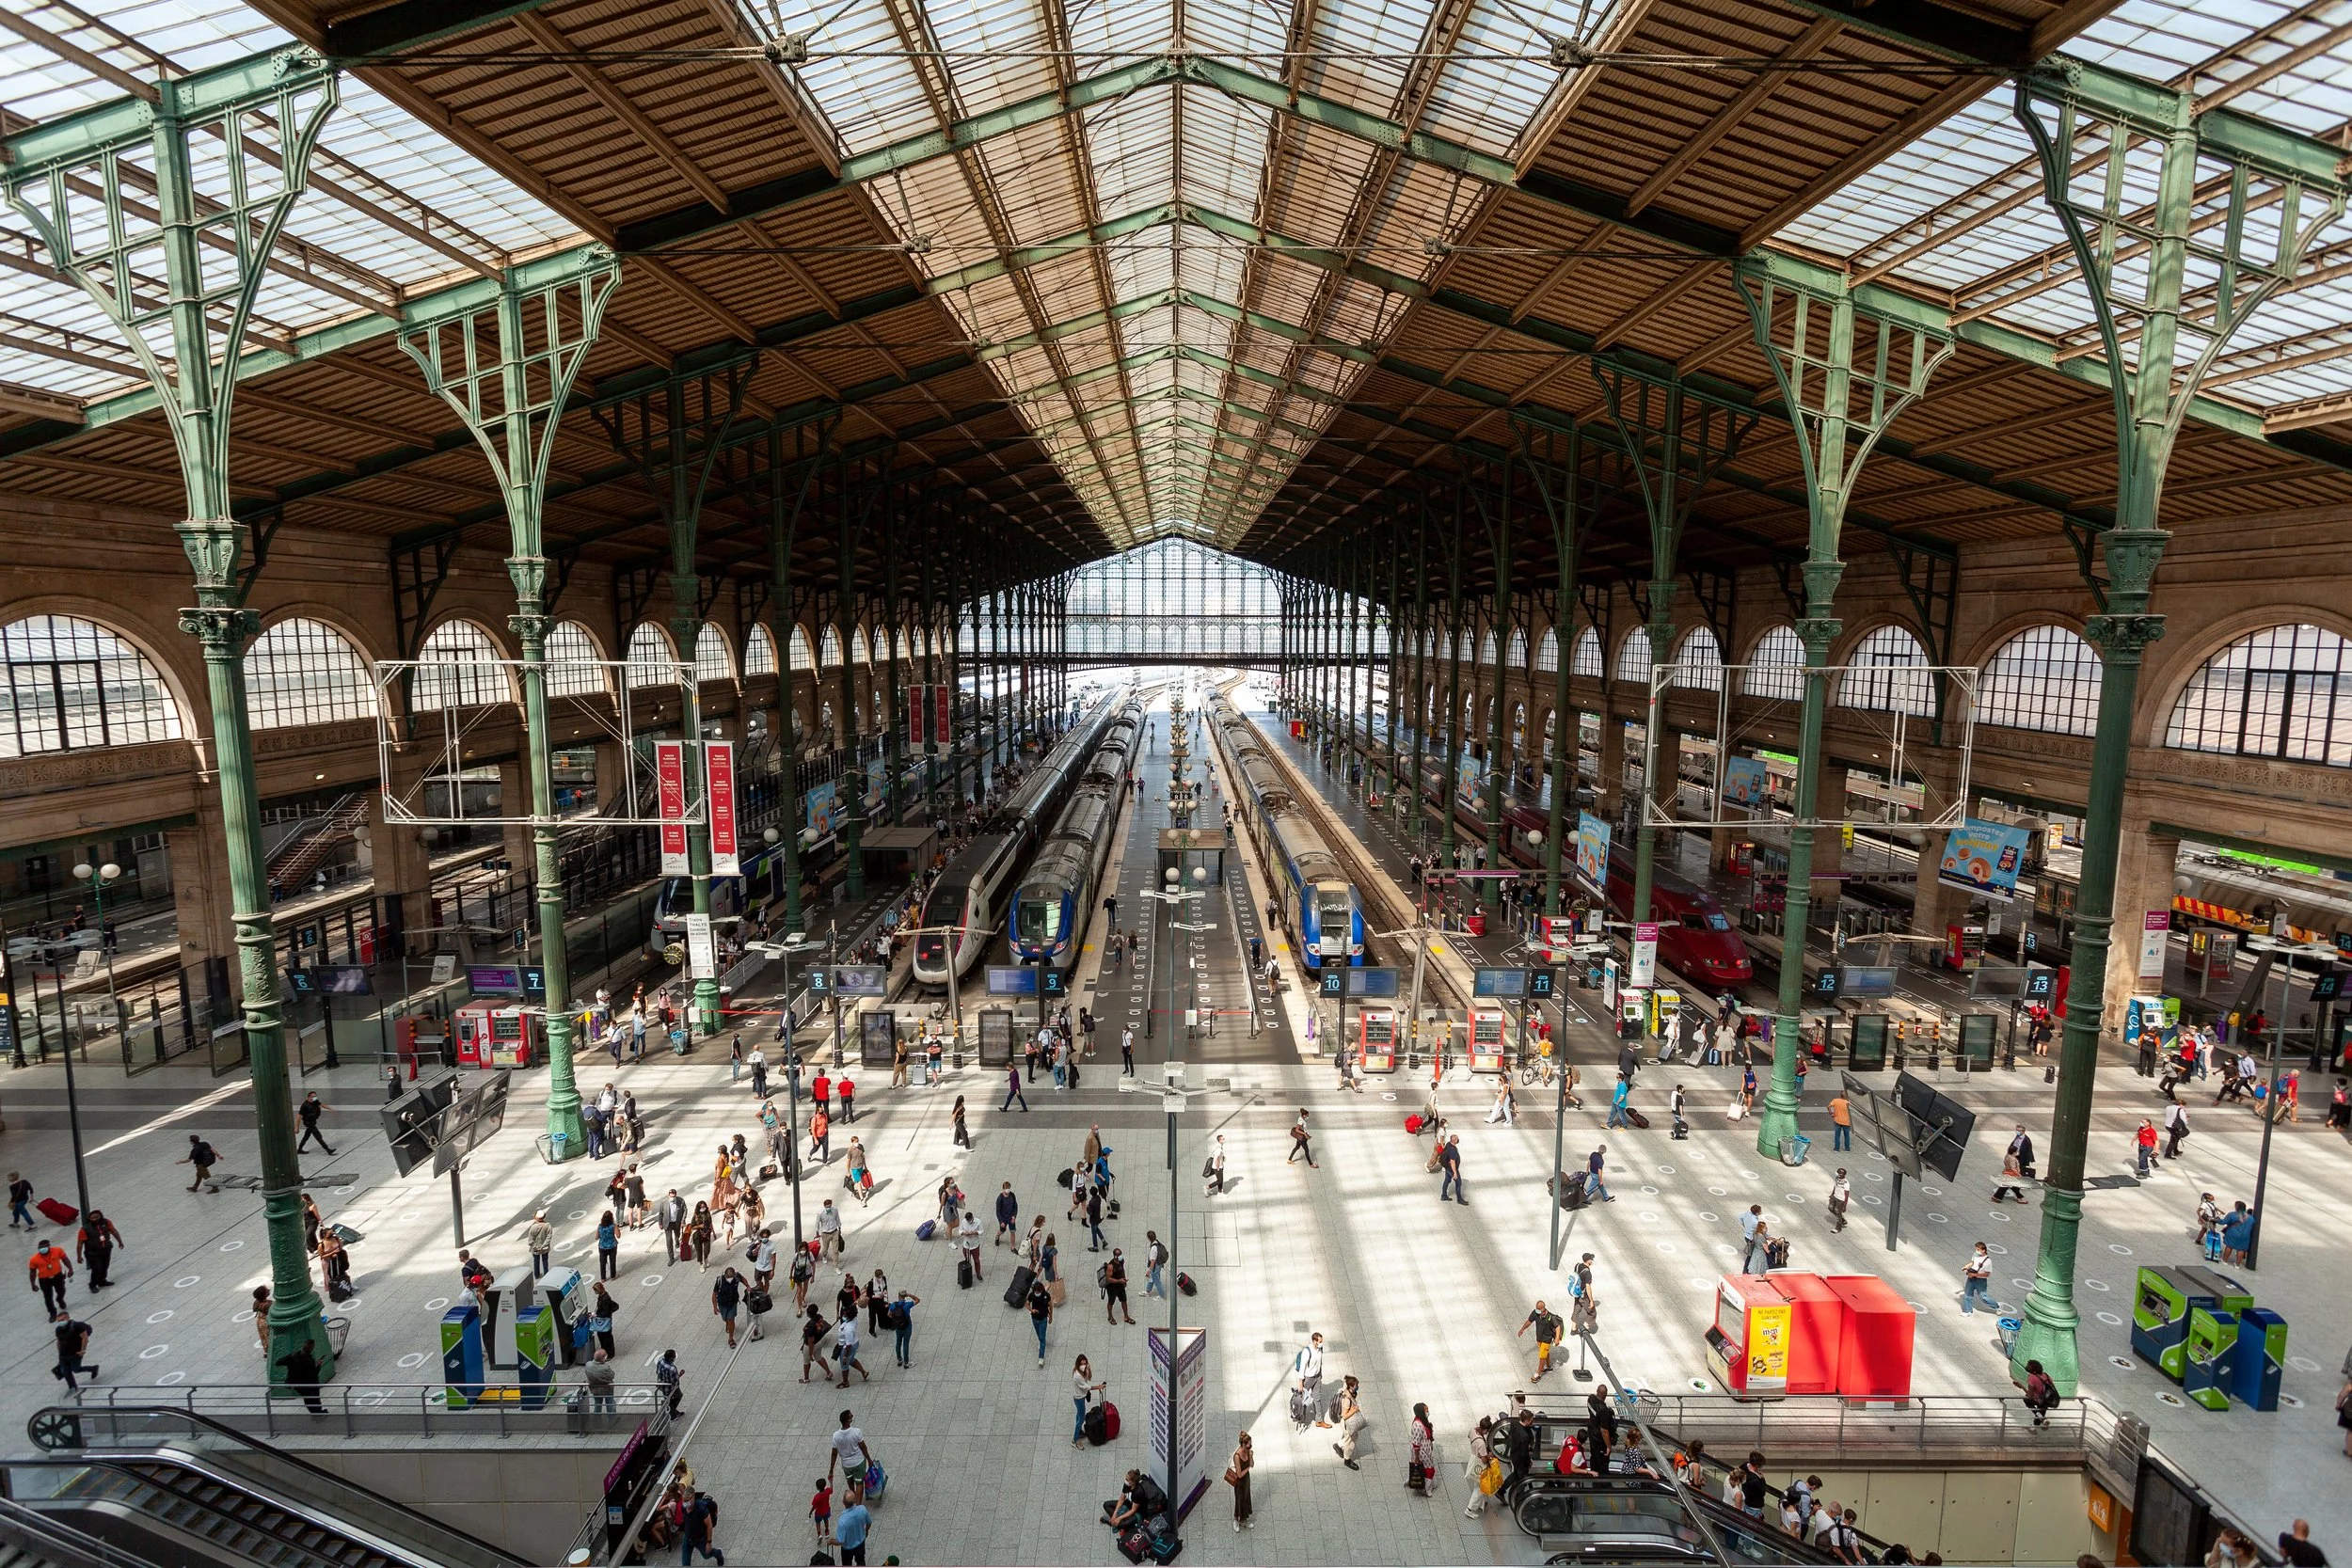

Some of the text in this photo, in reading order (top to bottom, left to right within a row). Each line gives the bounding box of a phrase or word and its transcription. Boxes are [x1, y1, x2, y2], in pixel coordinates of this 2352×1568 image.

[2026, 937, 2035, 947] 13
[298, 979, 308, 988] 6
[530, 978, 538, 987] 7
[815, 978, 823, 987] 8
[1049, 979, 1056, 988] 9
[1325, 980, 1339, 989] 10
[1535, 980, 1549, 989] 11
[1821, 979, 1835, 988] 12
[2033, 981, 2048, 990] 13
[2320, 982, 2334, 992] 14
